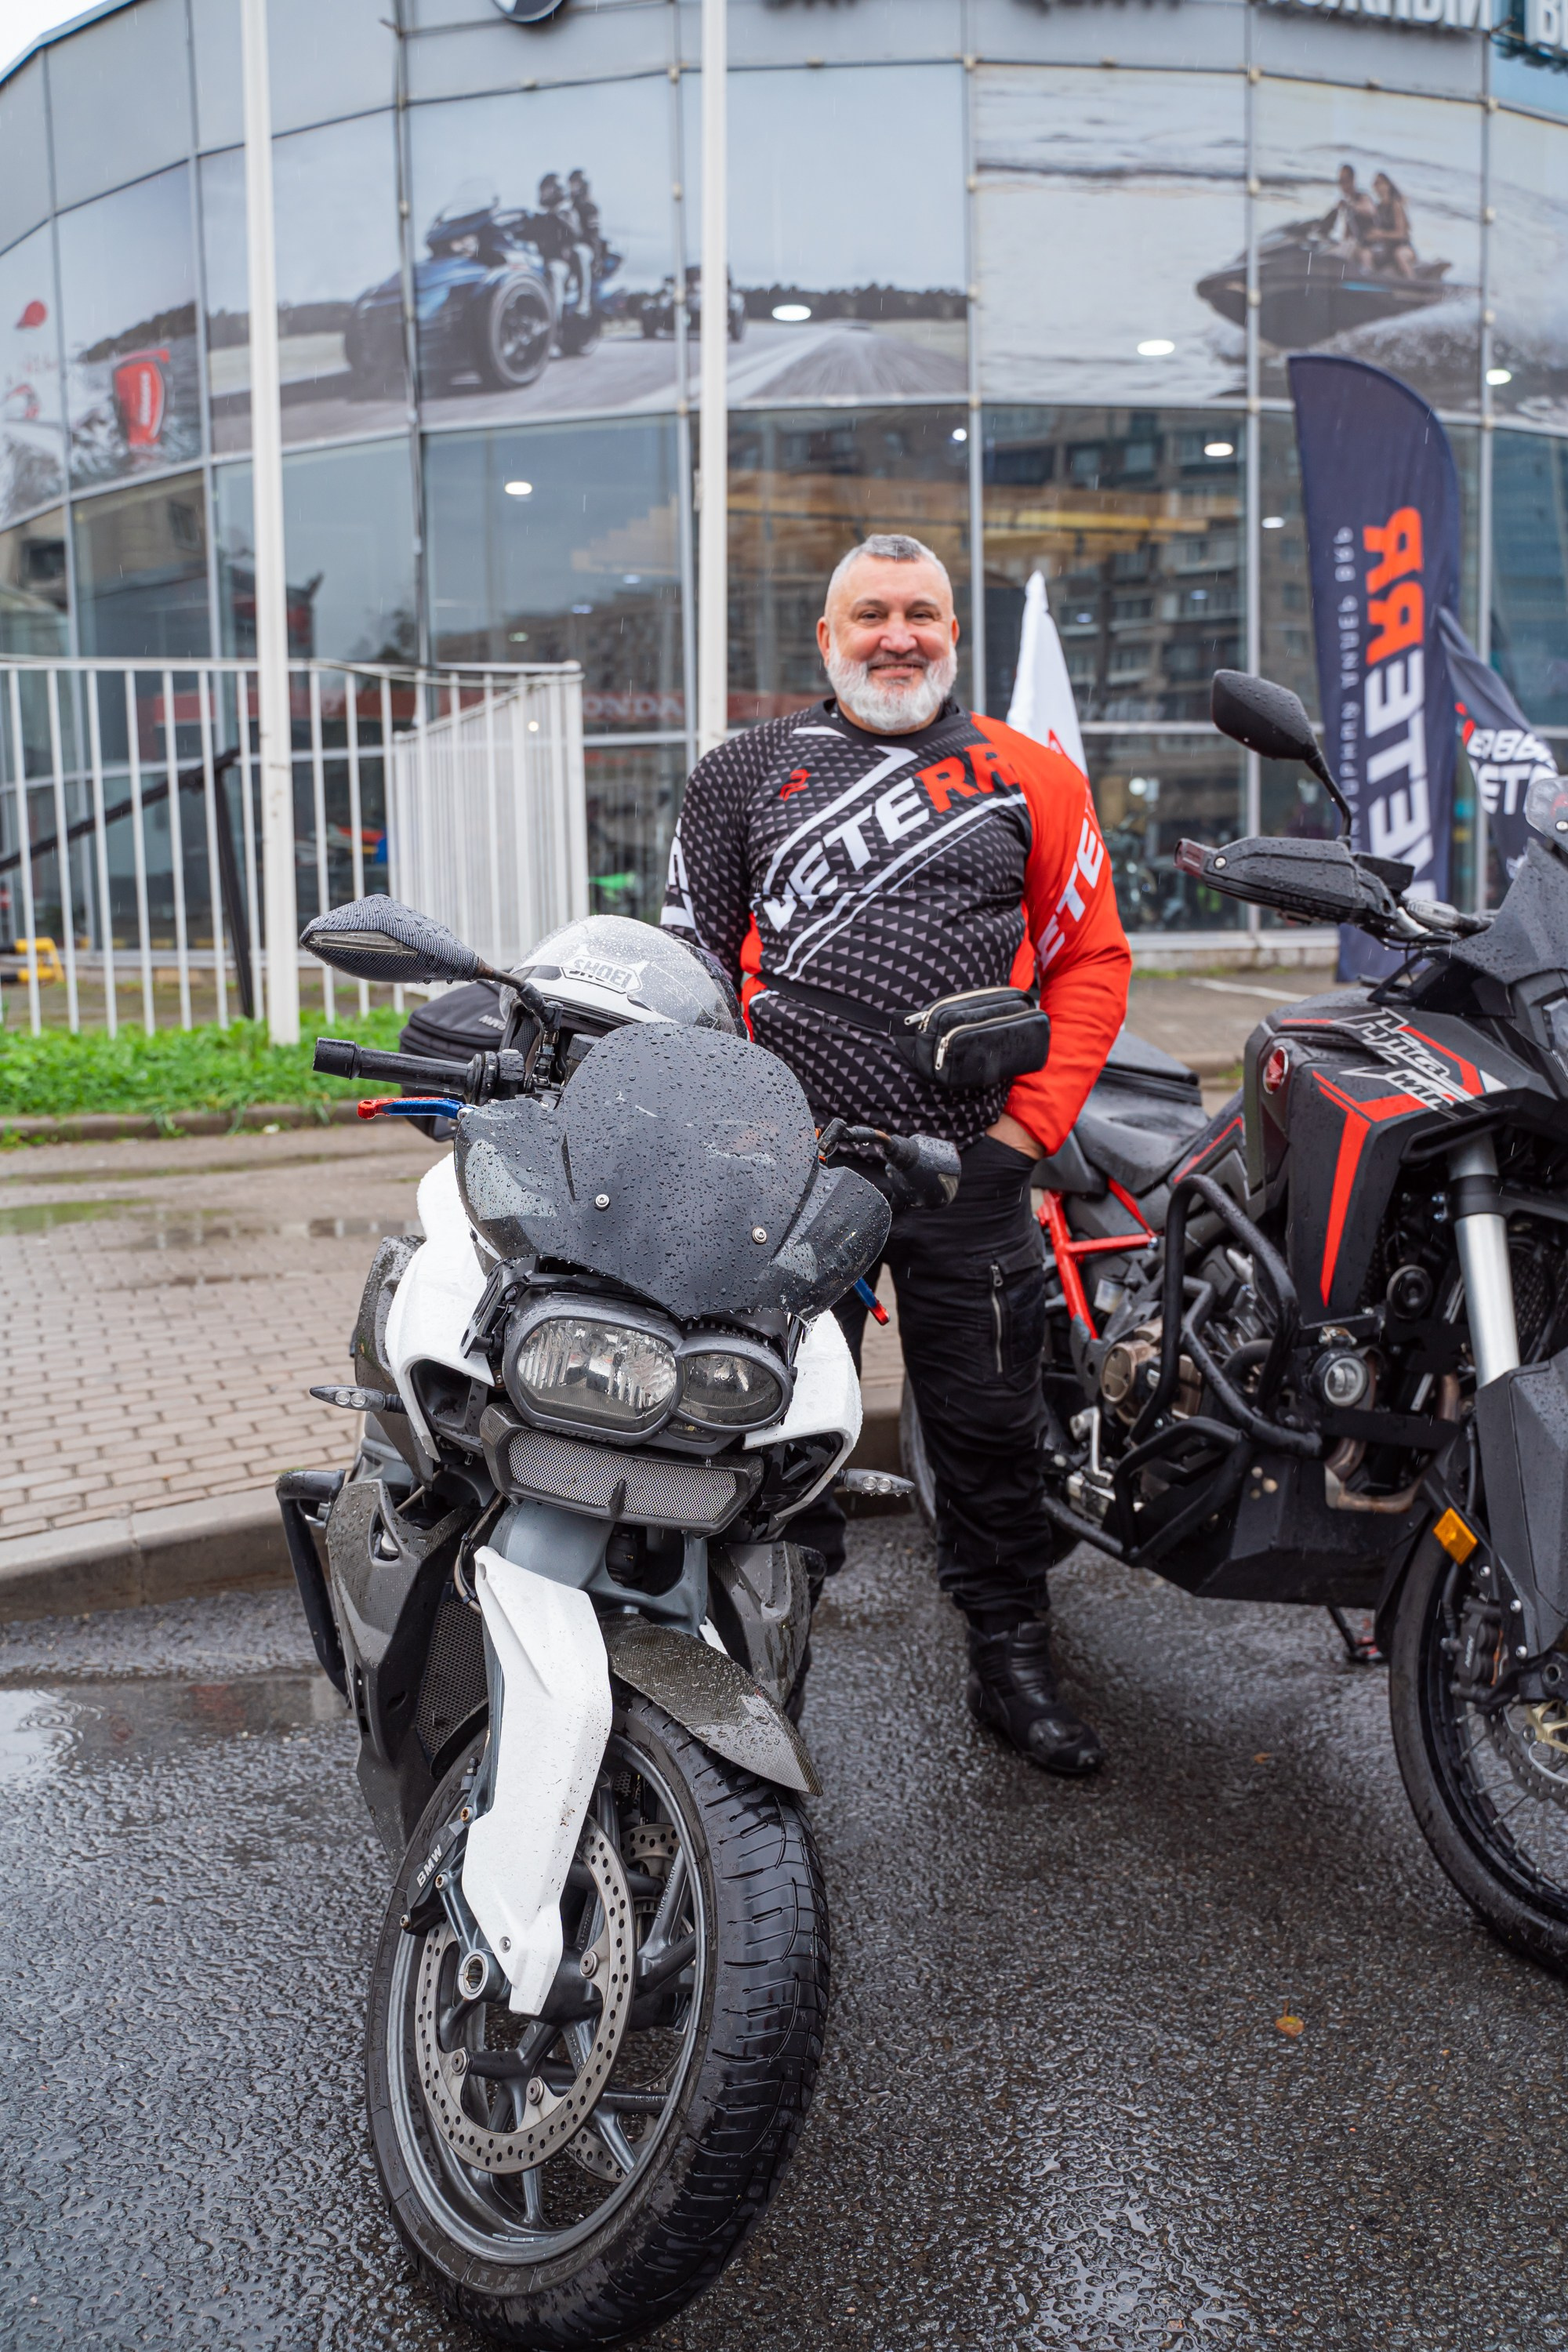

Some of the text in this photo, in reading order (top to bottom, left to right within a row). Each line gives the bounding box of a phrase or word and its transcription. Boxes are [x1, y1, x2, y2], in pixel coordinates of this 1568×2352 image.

[583, 694, 684, 719] ONDA
[568, 958, 633, 990] SHOEI
[416, 1844, 442, 1888] BMW
